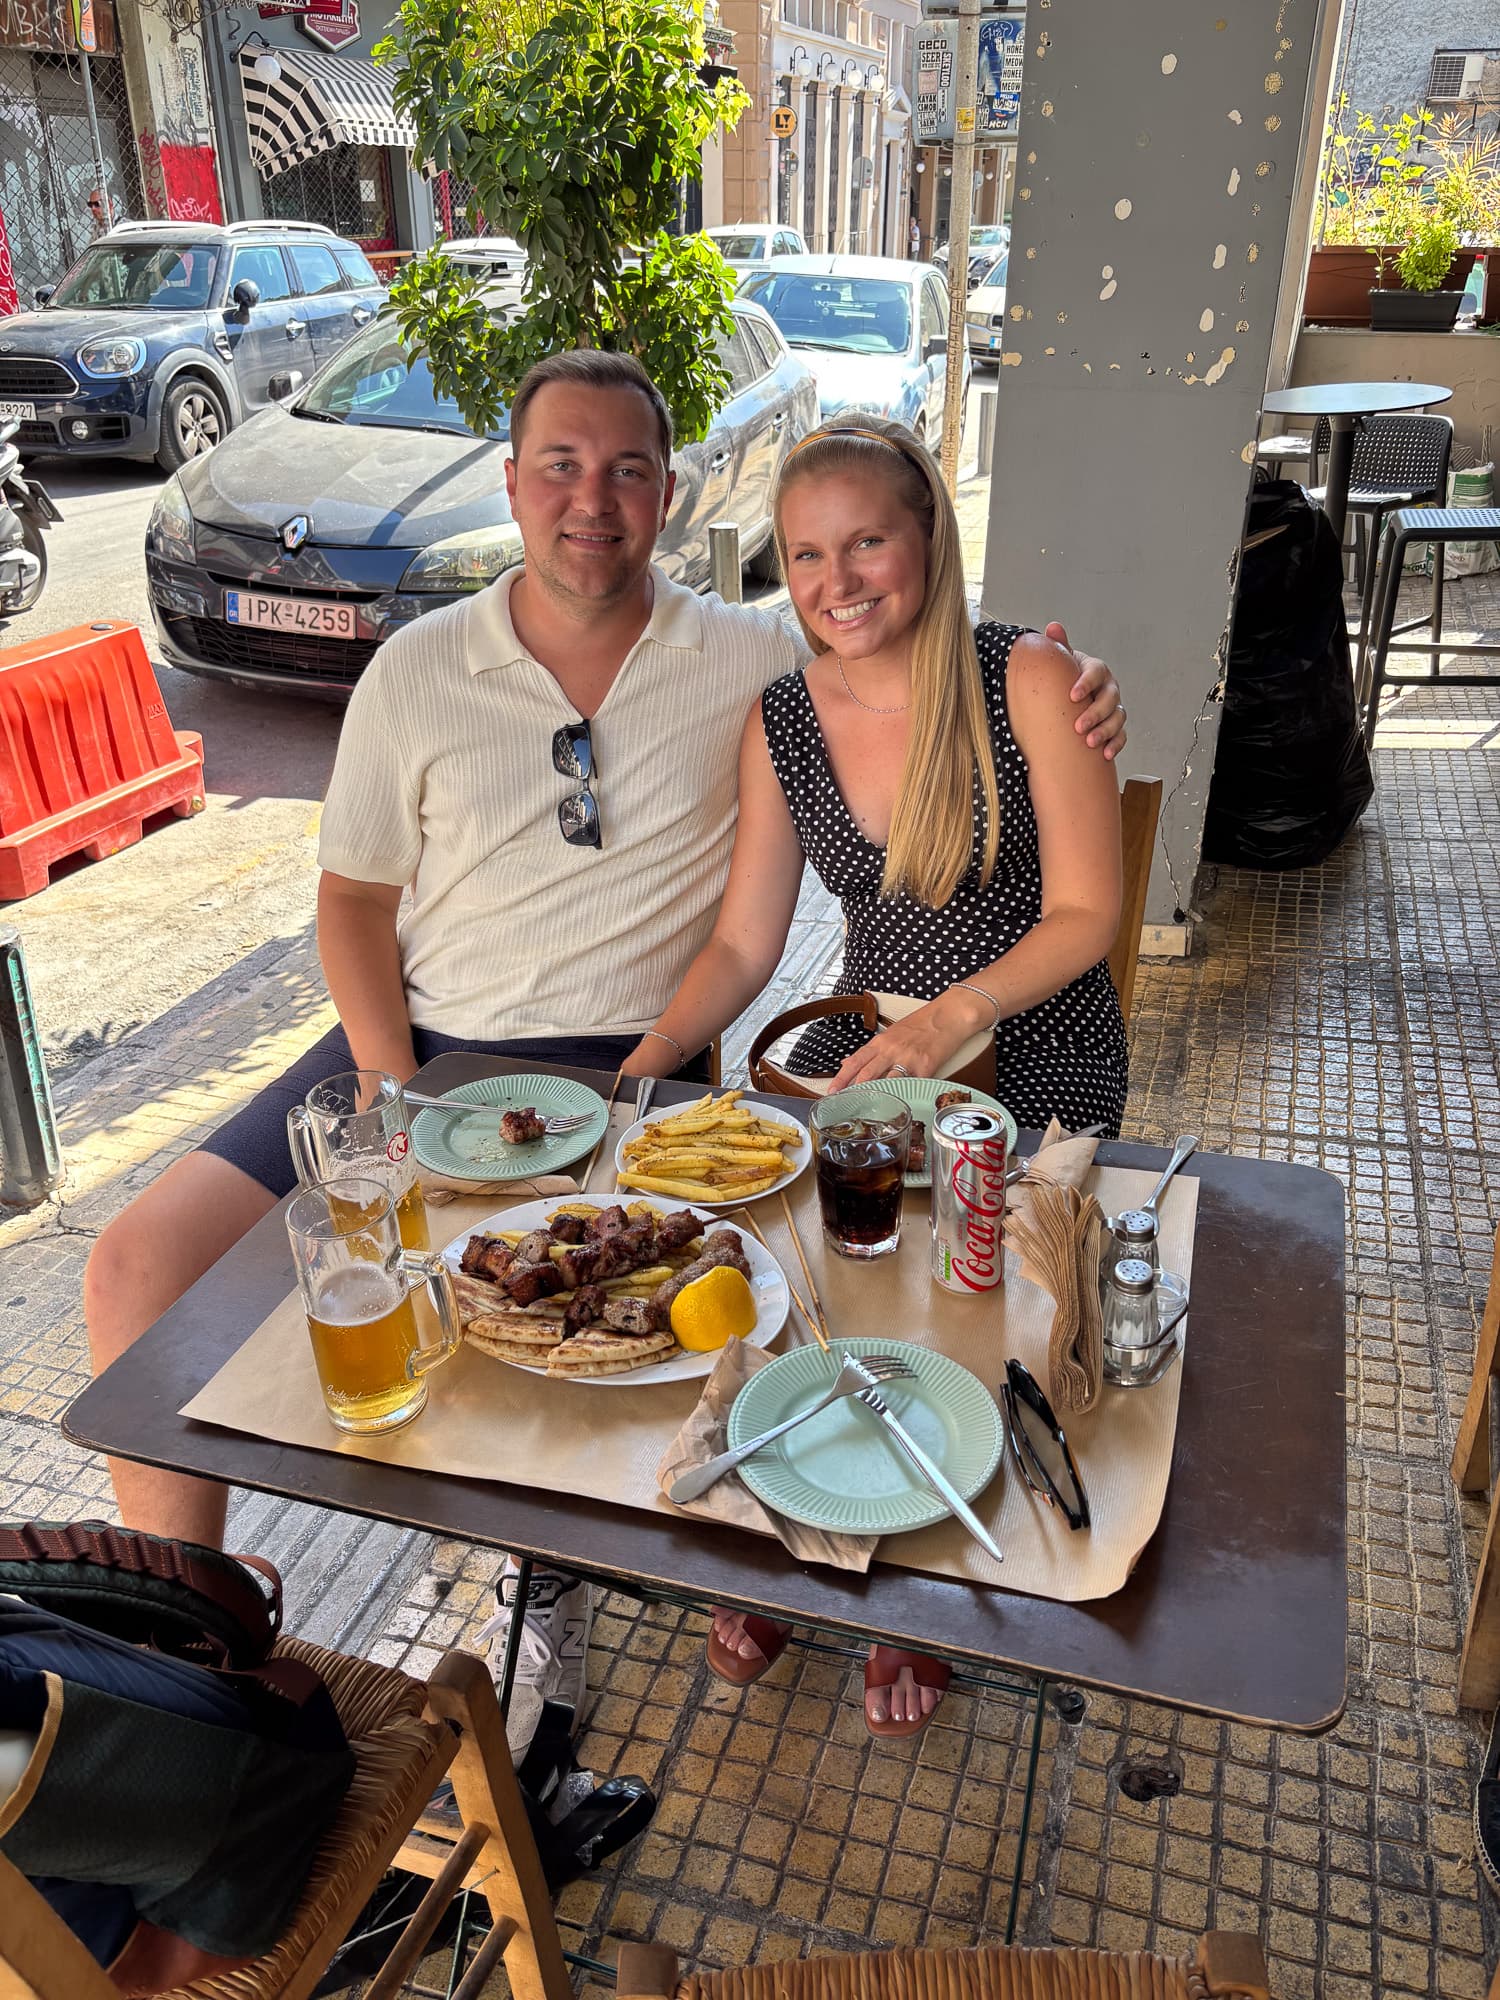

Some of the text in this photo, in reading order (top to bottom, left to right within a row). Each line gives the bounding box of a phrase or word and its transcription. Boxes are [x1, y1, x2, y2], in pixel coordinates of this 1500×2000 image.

[1006, 45, 1023, 54] HONE
[921, 52, 941, 62] SEER
[1001, 82, 1020, 91] MEOW
[917, 94, 937, 103] KAYAK
[248, 597, 351, 633] IPK-4259
[951, 1136, 1006, 1293] Coca-Cola
